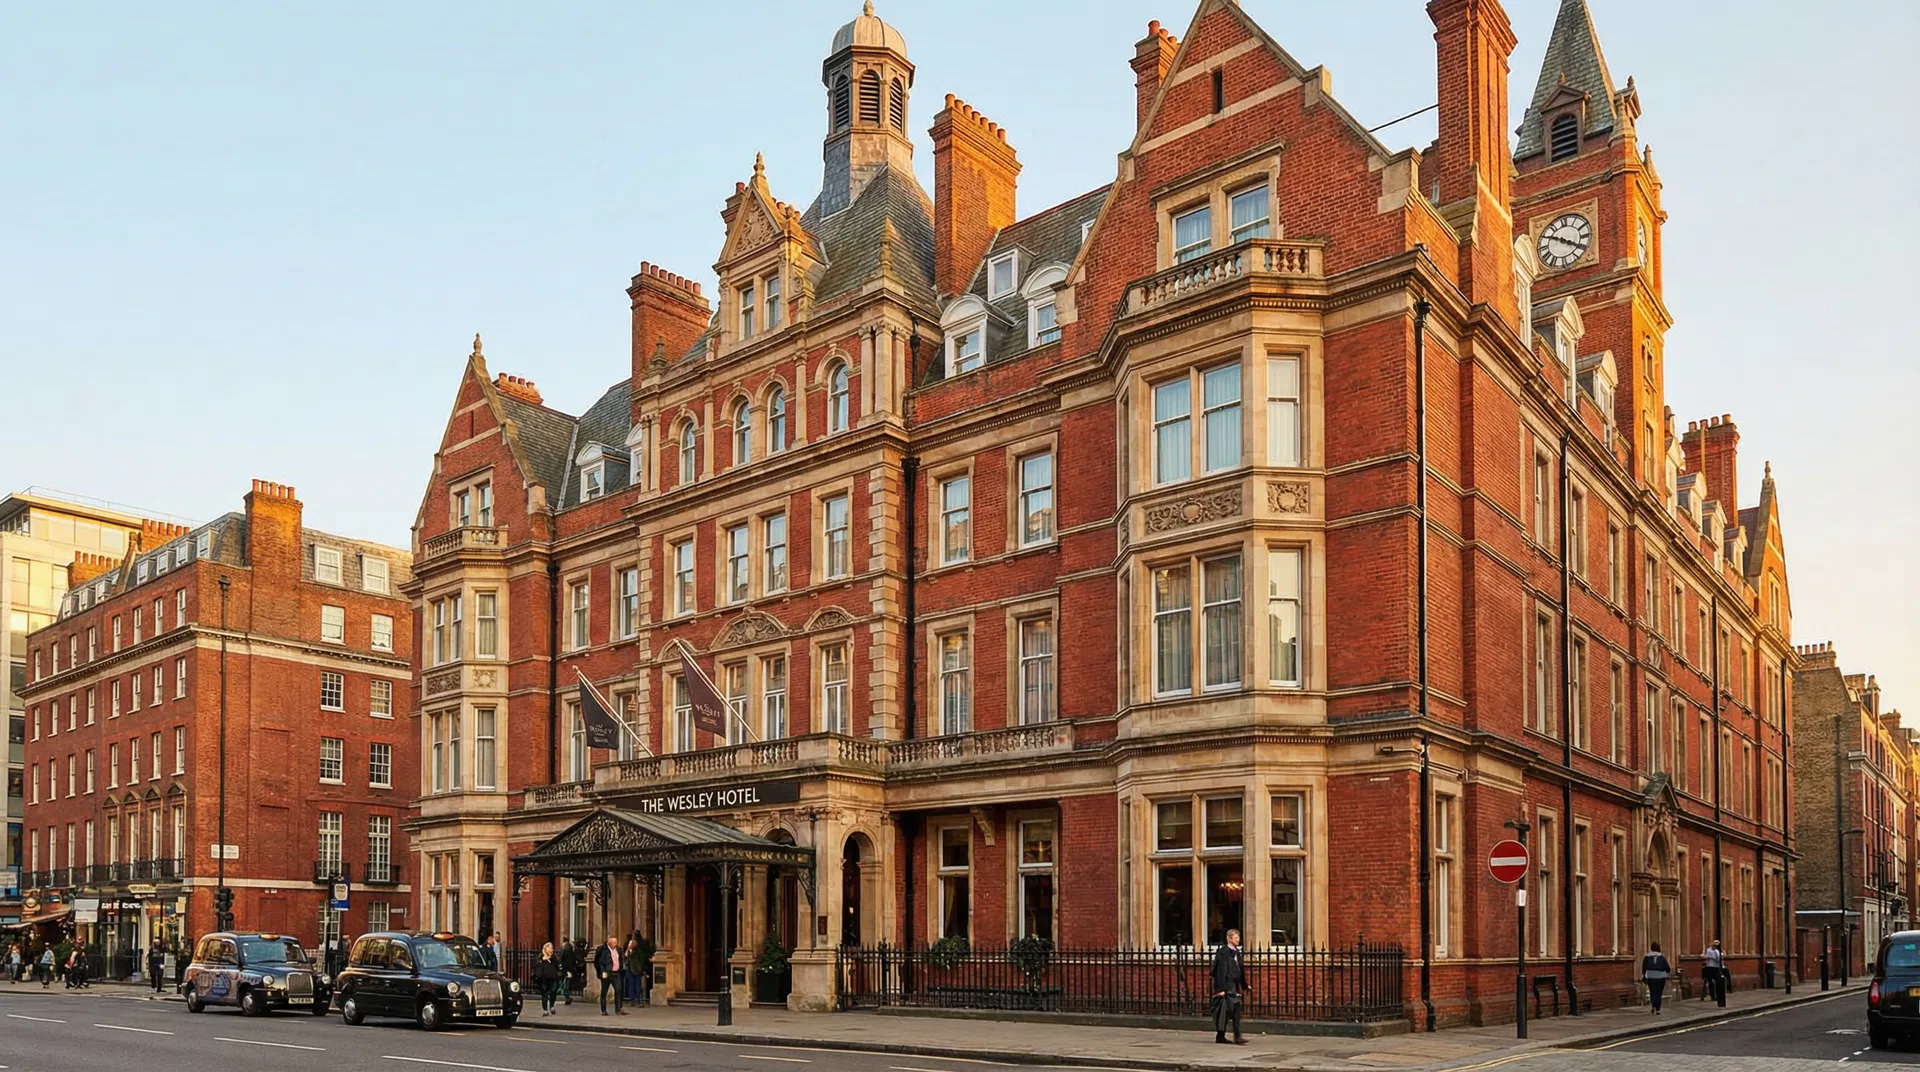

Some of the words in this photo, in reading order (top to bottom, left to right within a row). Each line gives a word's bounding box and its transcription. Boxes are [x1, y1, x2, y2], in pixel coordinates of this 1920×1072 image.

[641, 798, 664, 812] THE
[667, 792, 713, 811] WESLEY
[717, 787, 760, 806] HOTEL
